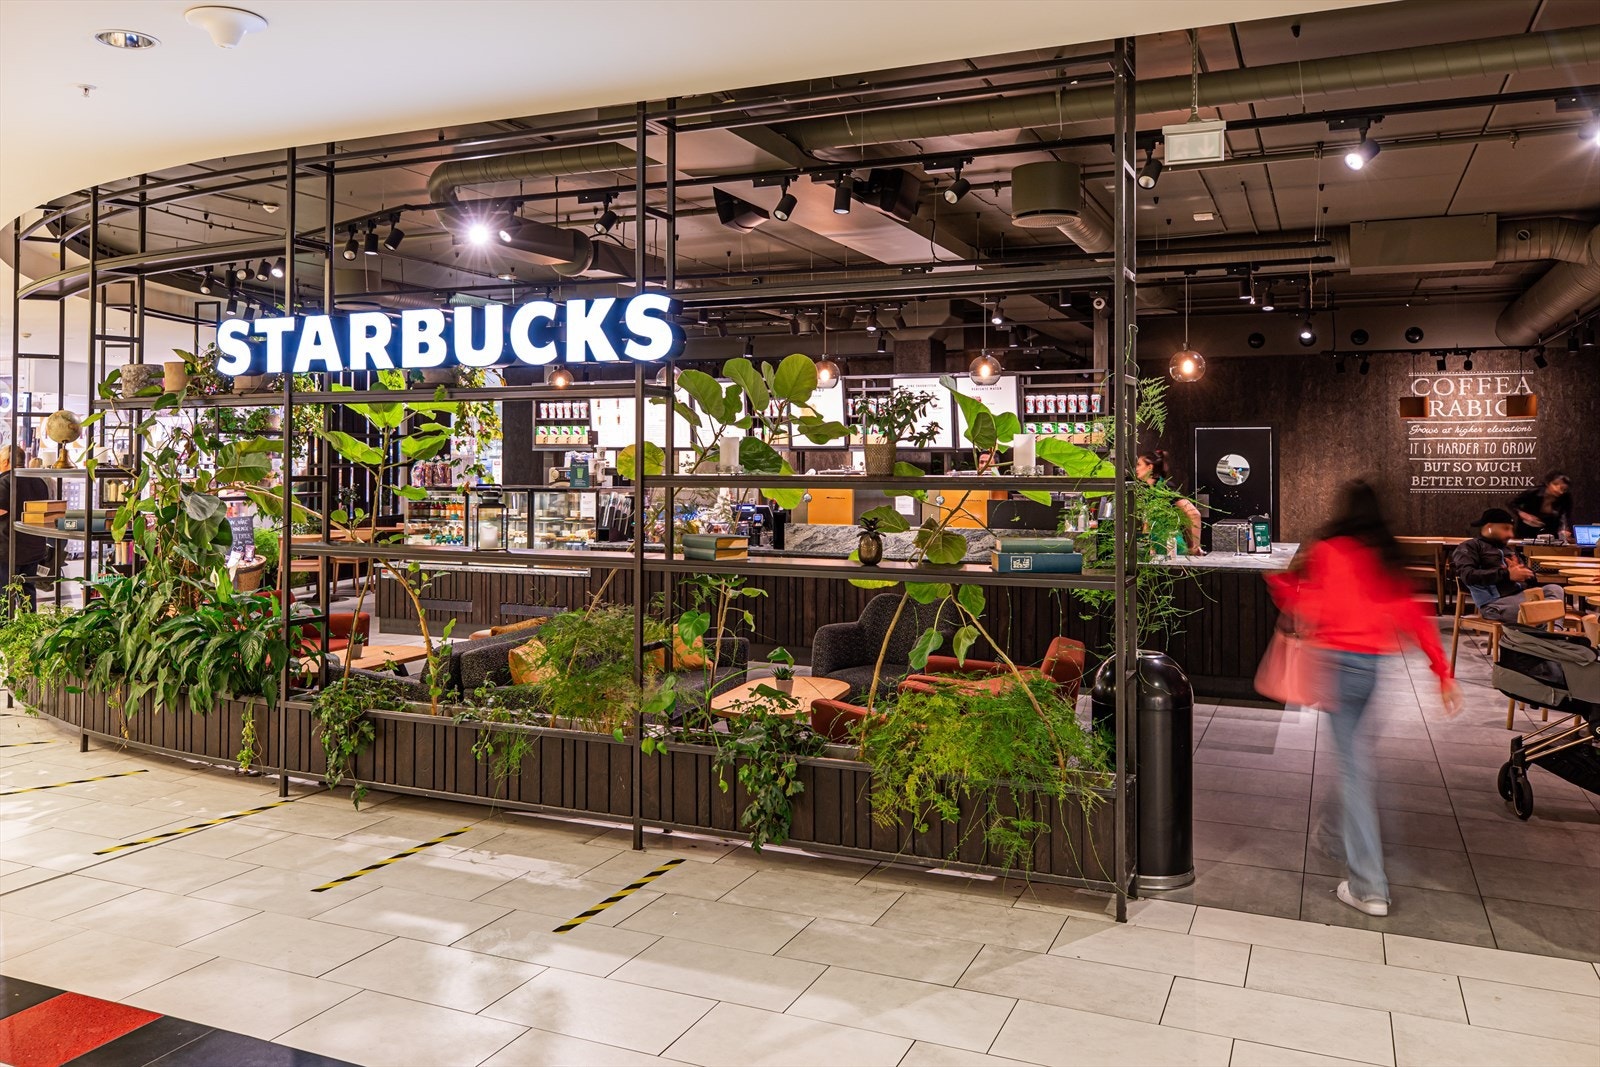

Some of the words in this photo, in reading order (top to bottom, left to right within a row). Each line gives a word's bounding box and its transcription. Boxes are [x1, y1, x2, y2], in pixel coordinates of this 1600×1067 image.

[217, 293, 673, 376] STARBUCKS
[1411, 376, 1533, 396] COFFEA
[1429, 399, 1507, 417] RABIC
[1409, 425, 1439, 435] Grows
[1442, 426, 1453, 434] at
[1454, 424, 1483, 436] higher
[1487, 424, 1532, 433] elevations
[1409, 442, 1419, 455] IT
[1423, 442, 1433, 455] IS
[1437, 442, 1480, 455] HARDER
[1484, 442, 1497, 455] TO
[1502, 441, 1537, 455] GROW
[1424, 462, 1450, 472] BUT
[1453, 462, 1472, 472] SO
[1476, 462, 1521, 472] MUCH
[1411, 475, 1464, 486] BETTER
[1465, 475, 1486, 486] TO
[1489, 475, 1535, 486] DRINK
